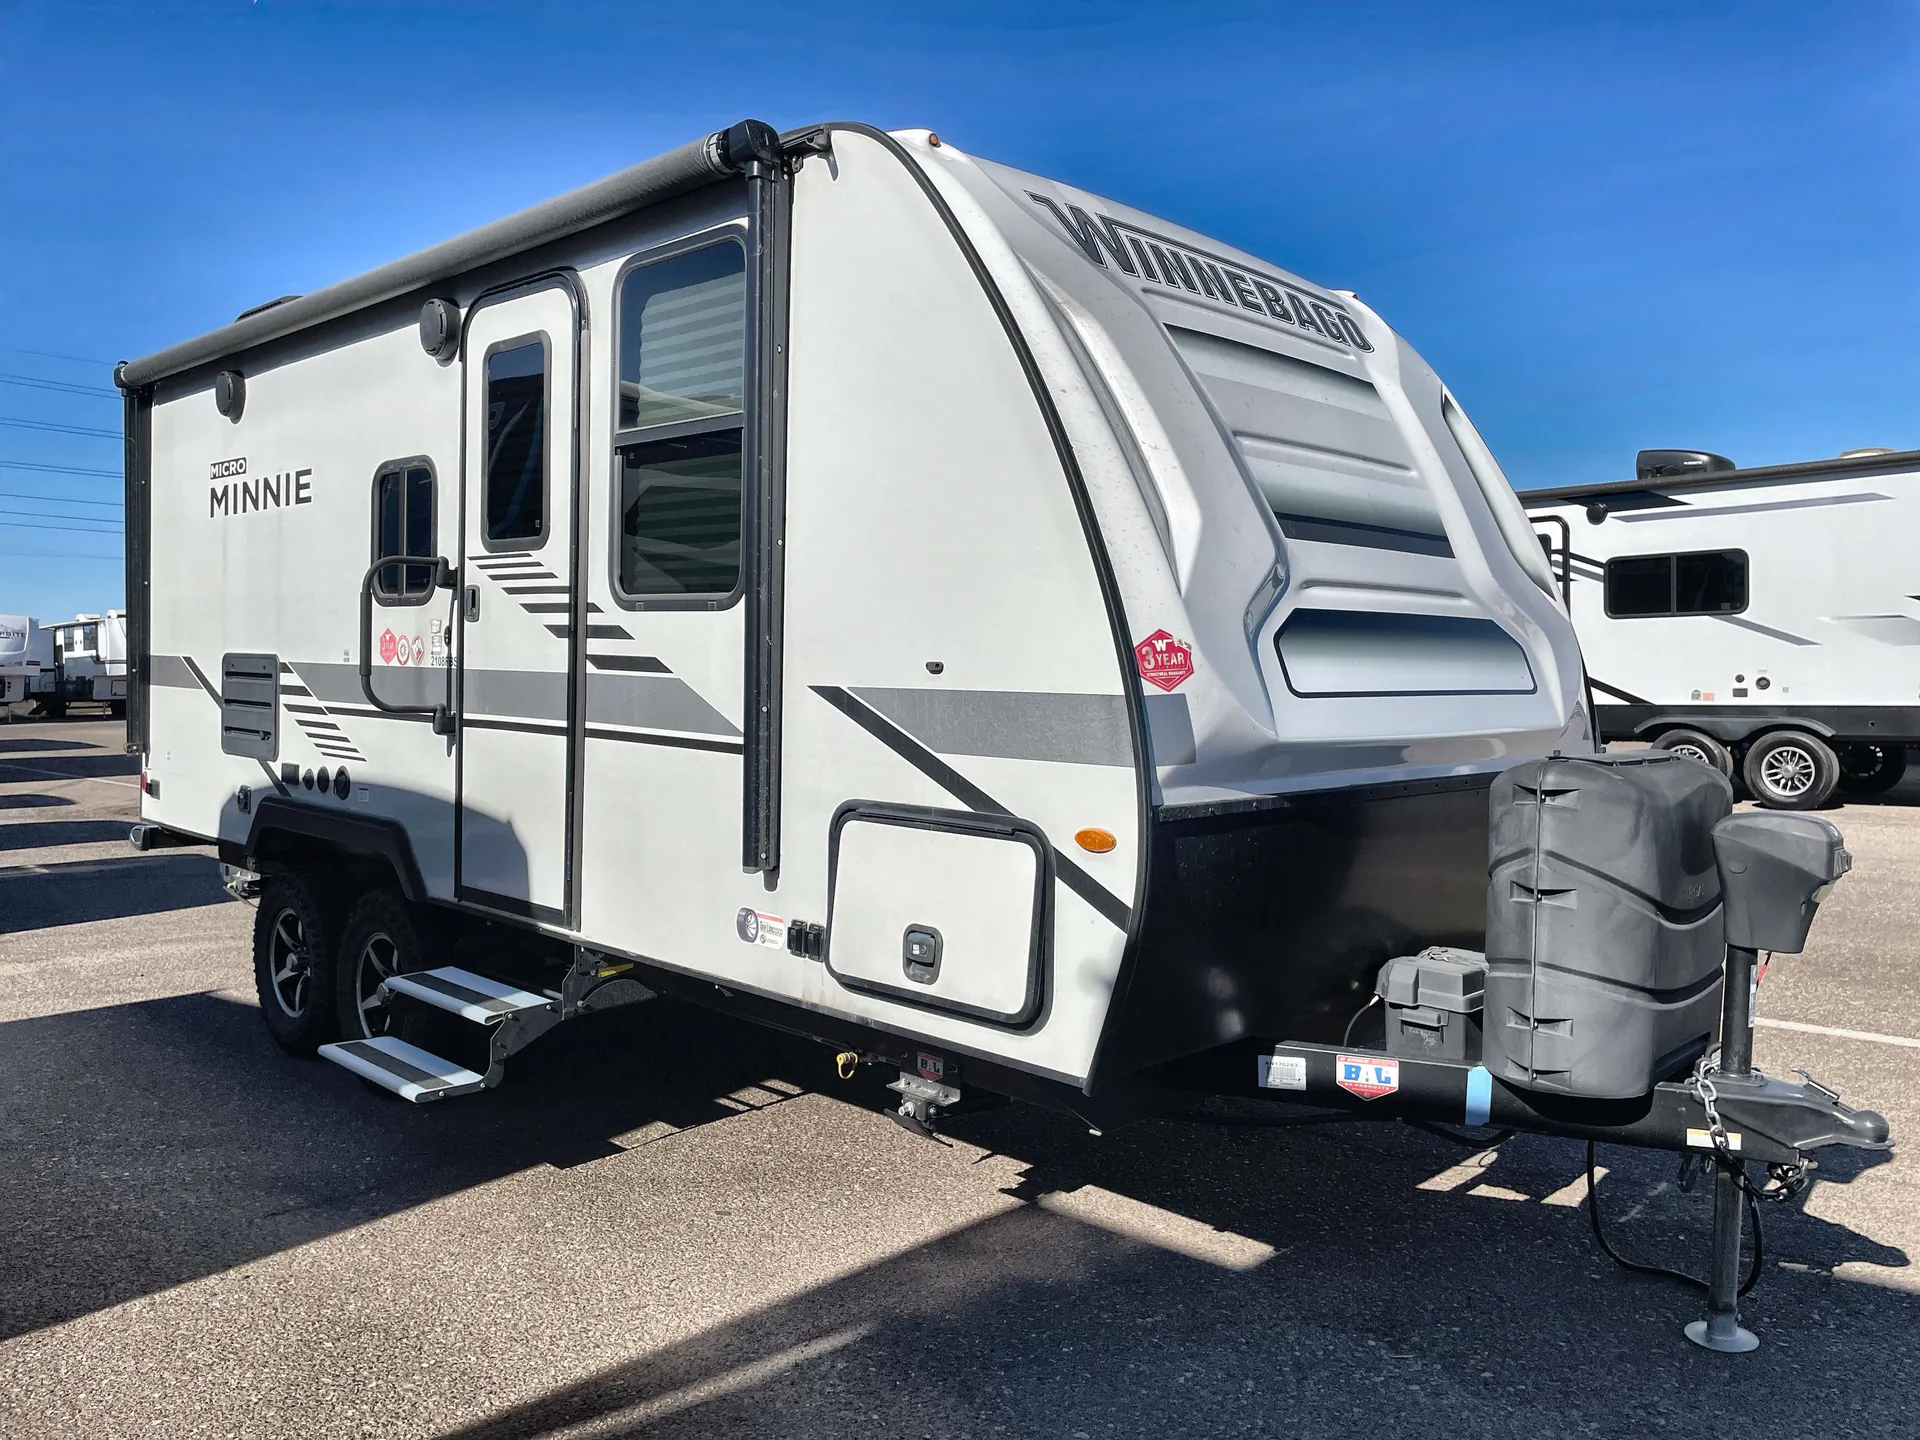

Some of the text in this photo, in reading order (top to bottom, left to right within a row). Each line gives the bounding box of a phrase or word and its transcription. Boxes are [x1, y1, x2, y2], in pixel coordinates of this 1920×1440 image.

[1024, 189, 1374, 353] WINNEBAGO
[210, 458, 246, 478] MICRO
[209, 468, 312, 518] MINNIE
[1141, 646, 1185, 670] 3 YEAR
